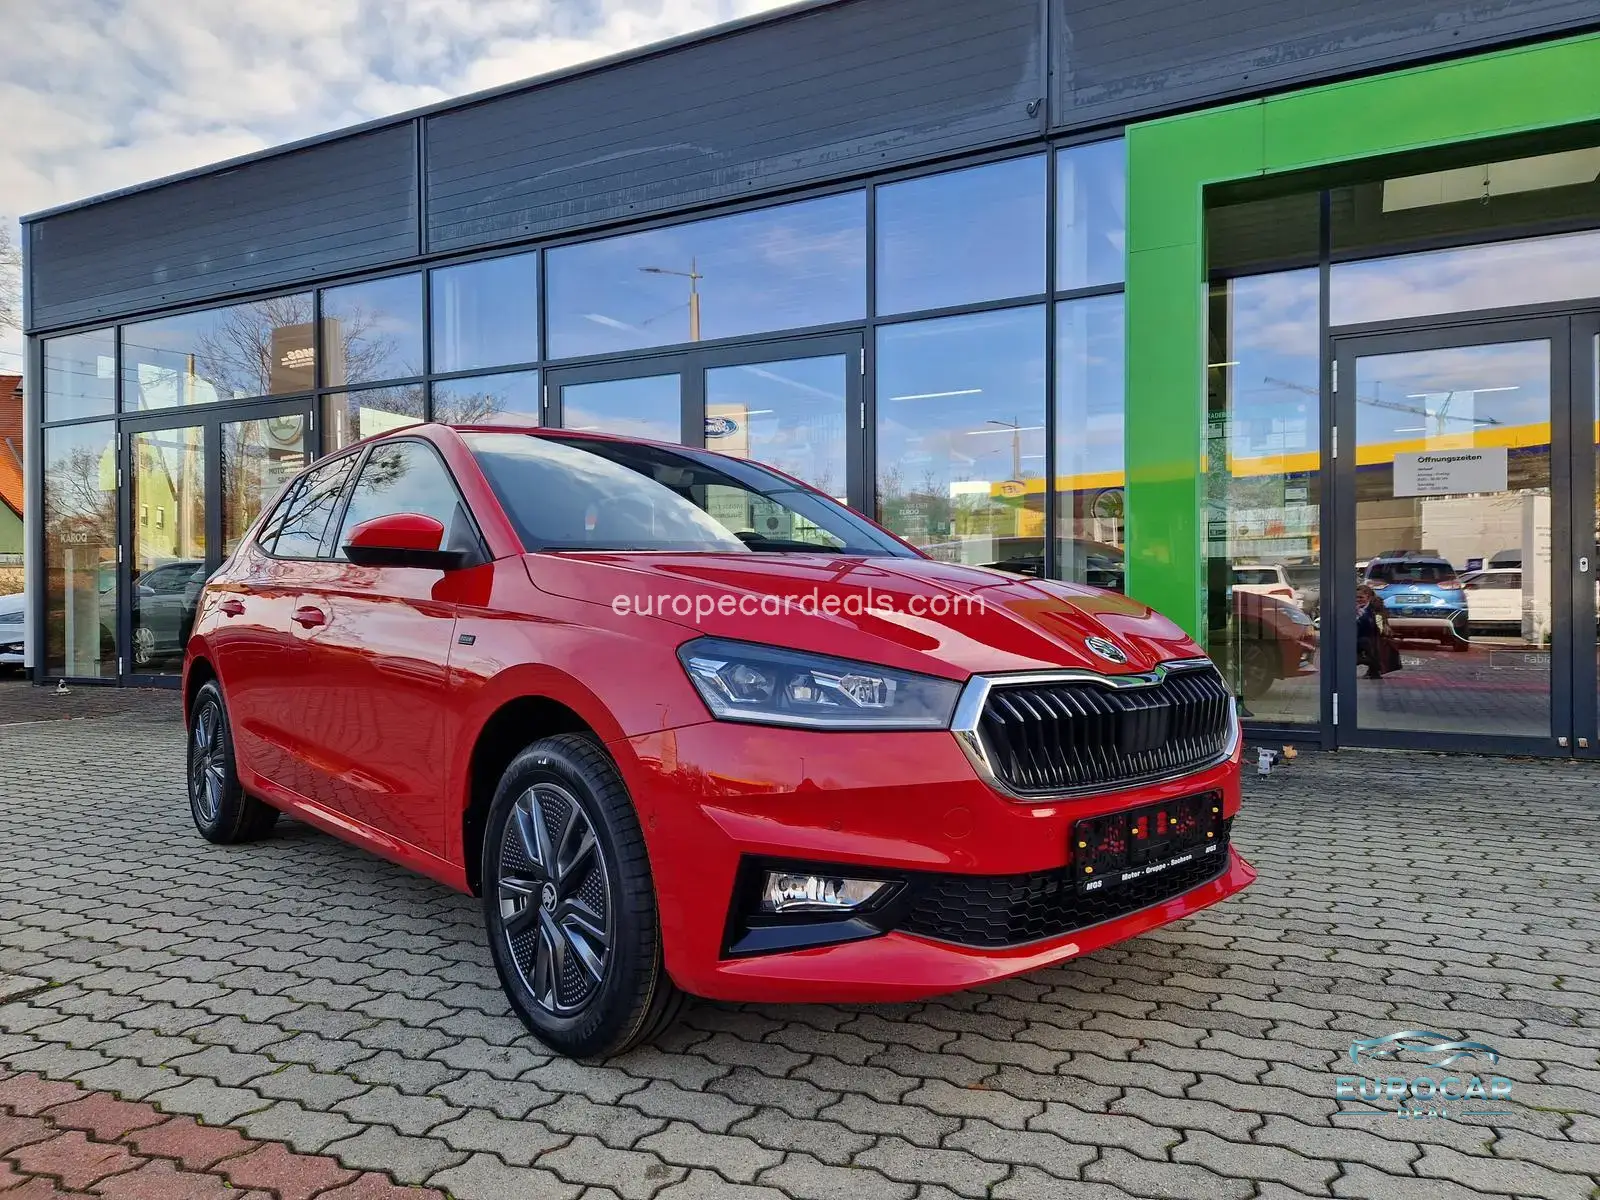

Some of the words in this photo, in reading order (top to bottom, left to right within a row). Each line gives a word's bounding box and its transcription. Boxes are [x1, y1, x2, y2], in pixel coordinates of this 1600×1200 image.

[1417, 454, 1482, 464] Öffnungszeiten
[1205, 845, 1217, 854] MGS
[1086, 880, 1103, 891] MGS
